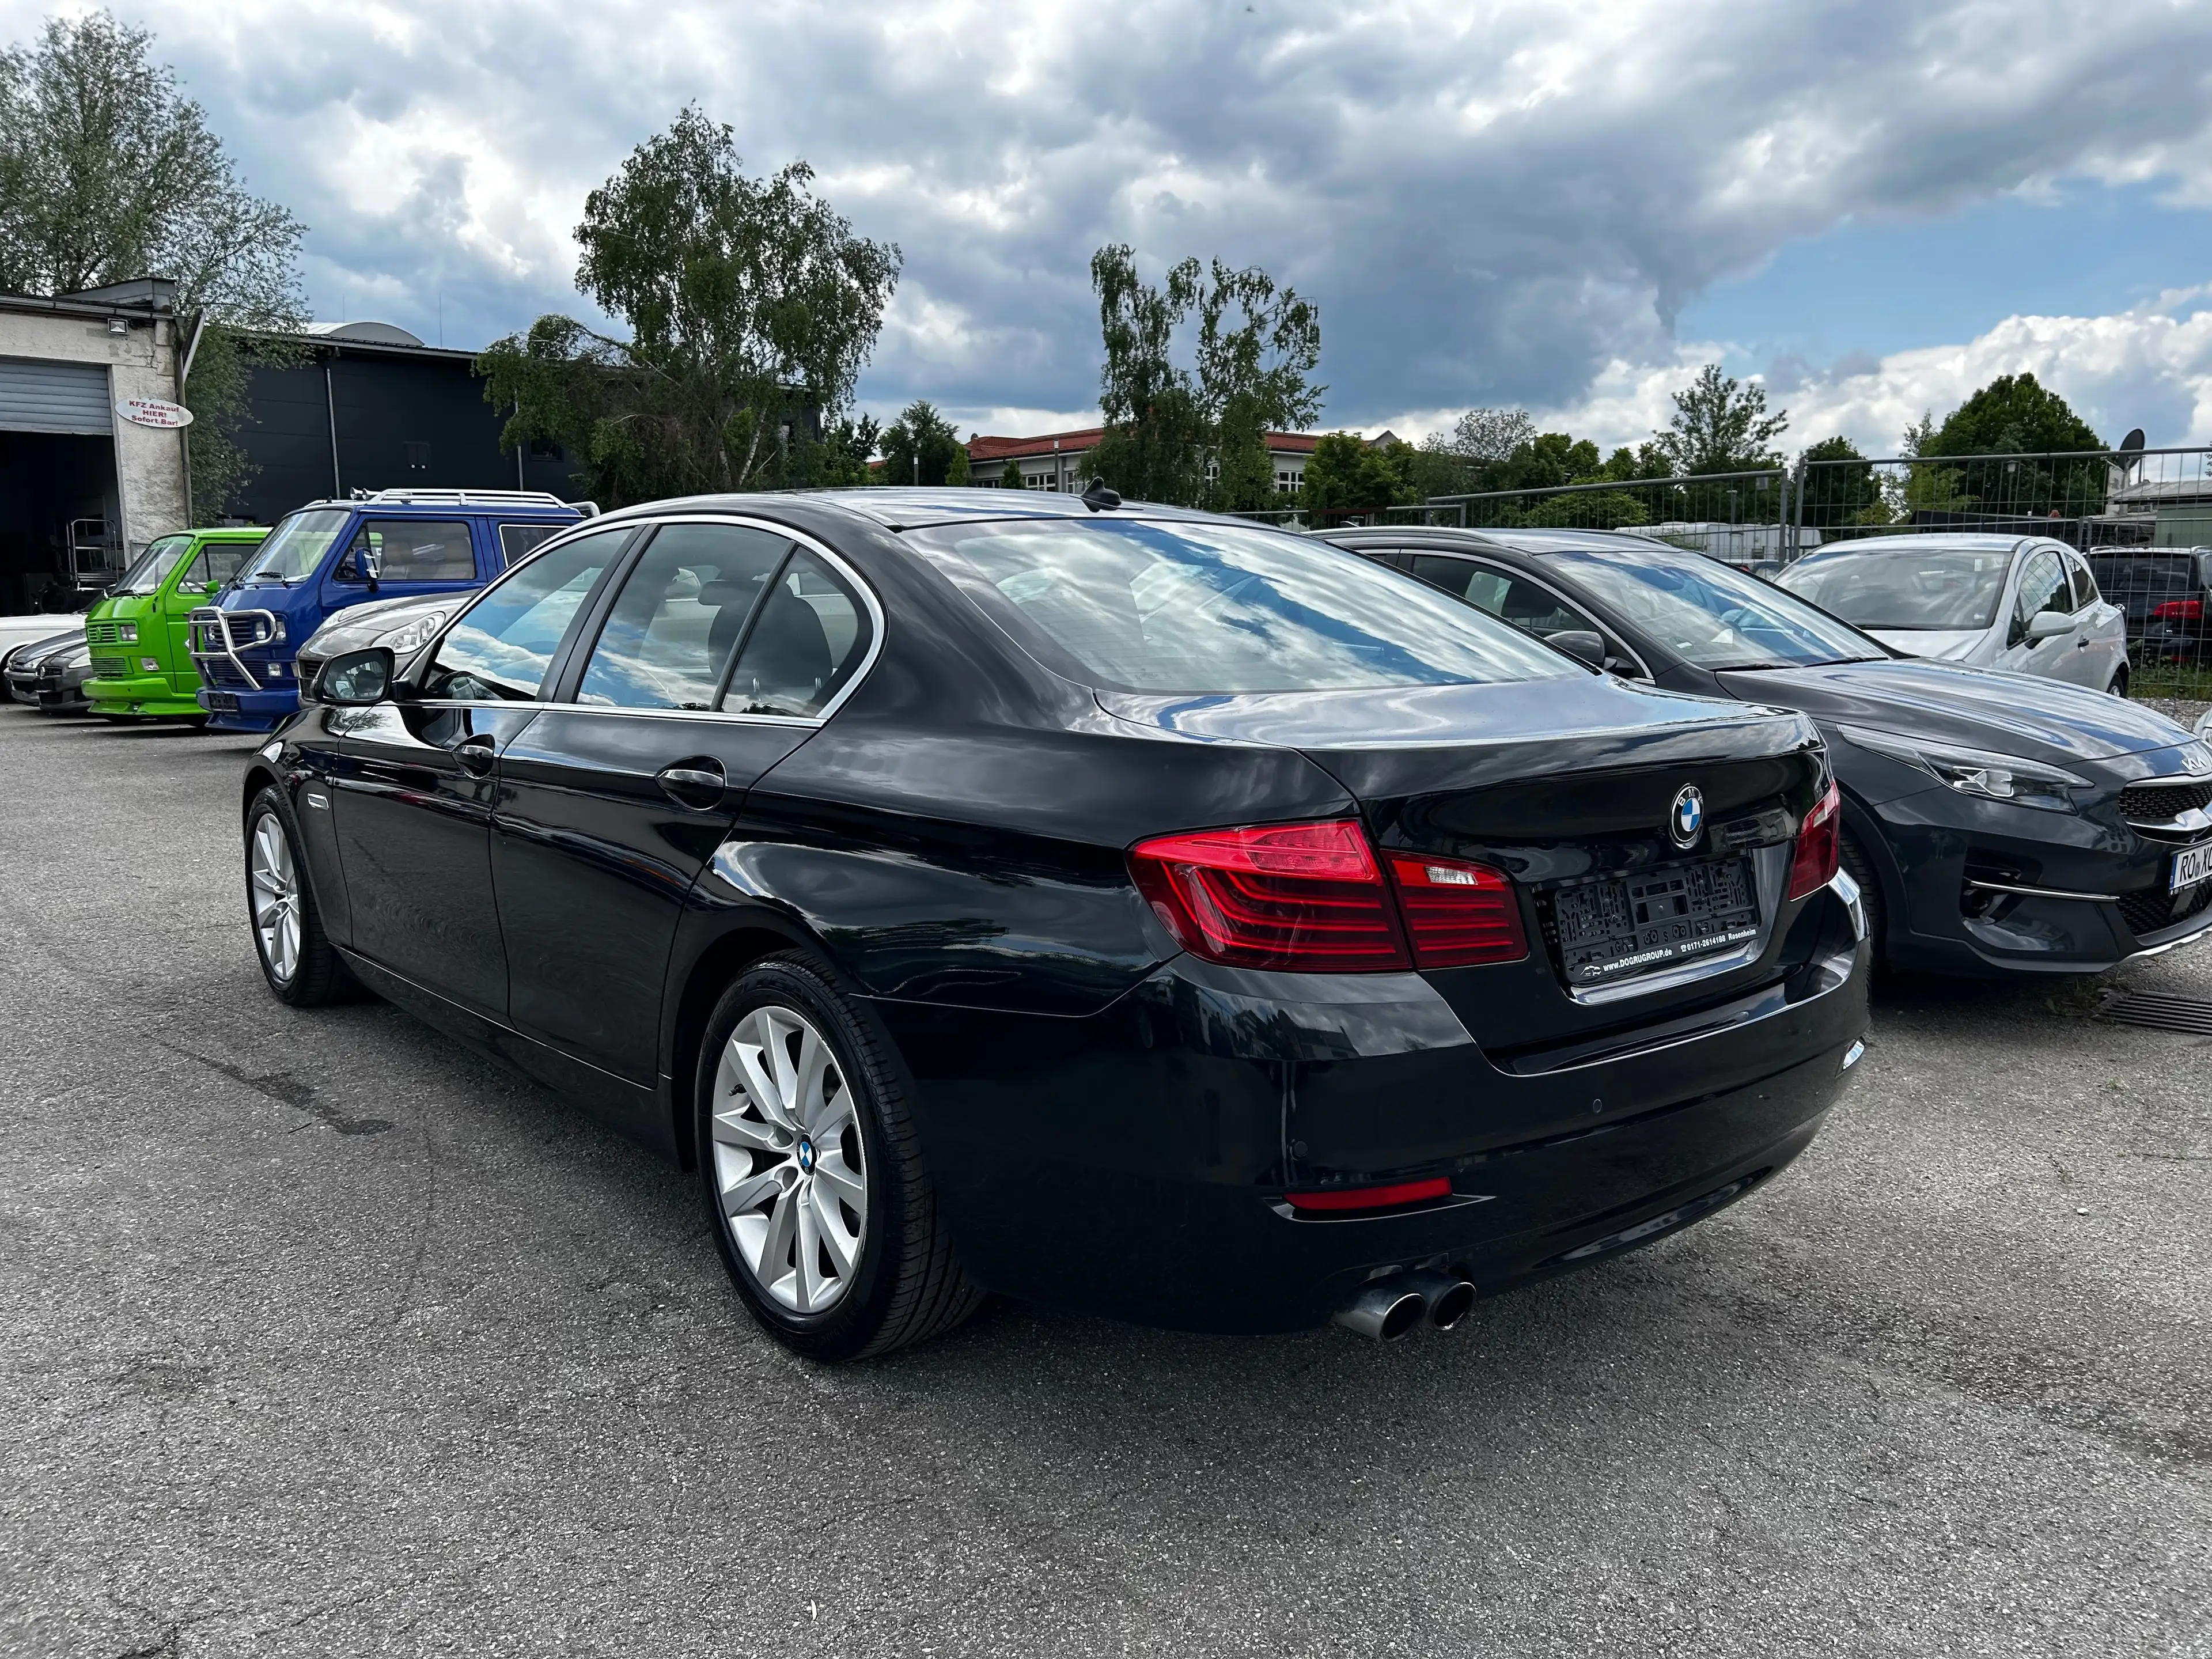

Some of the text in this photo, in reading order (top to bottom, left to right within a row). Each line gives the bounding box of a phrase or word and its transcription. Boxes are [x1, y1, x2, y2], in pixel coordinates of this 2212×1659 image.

[149, 403, 179, 412] Ankauf
[142, 410, 166, 418] HIER!
[131, 415, 158, 424] Sofort
[2179, 853, 2196, 882] RO
[1603, 948, 1673, 972] www.DOGRUGROUP.de
[1728, 928, 1756, 941] Rosenheim
